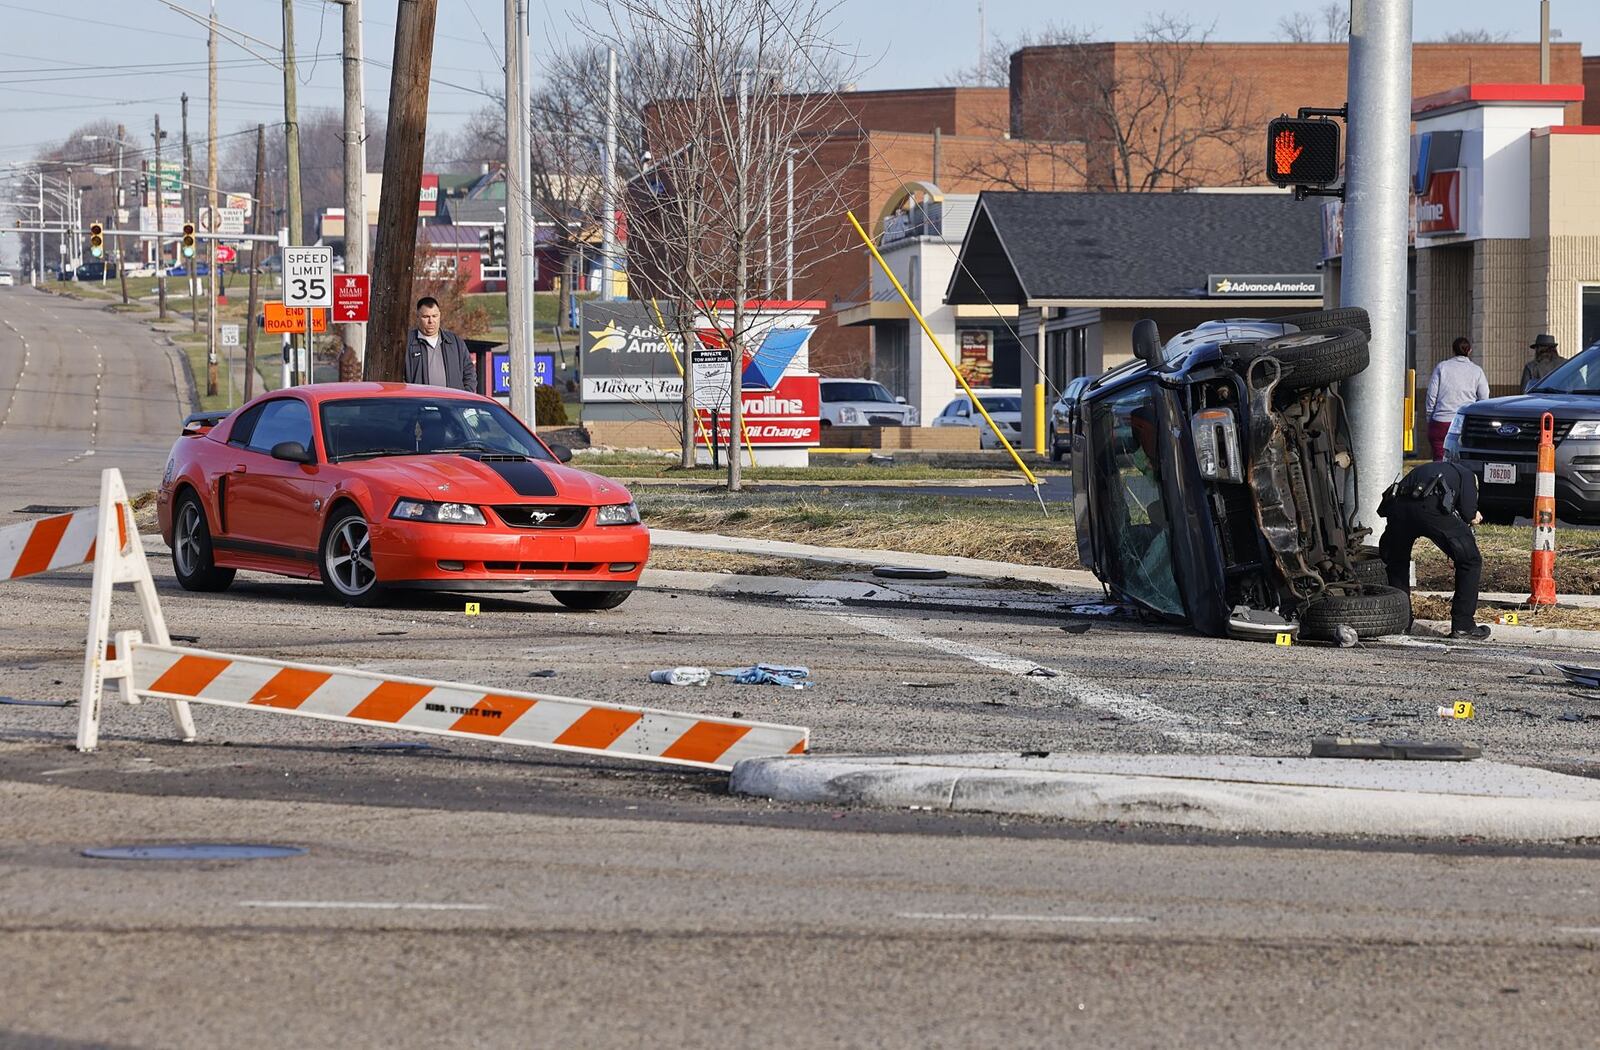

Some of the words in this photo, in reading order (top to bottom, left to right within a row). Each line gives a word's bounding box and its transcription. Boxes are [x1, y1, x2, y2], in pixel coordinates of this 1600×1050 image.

[288, 254, 328, 263] SPEED
[292, 266, 323, 275] LIMIT
[291, 279, 326, 299] 35
[285, 307, 304, 316] END
[267, 320, 293, 329] ROAD
[297, 319, 322, 328] WRK
[224, 335, 237, 343] 35
[626, 339, 684, 353] Americ
[593, 381, 653, 393] Master's
[659, 380, 683, 393] Tou
[744, 426, 761, 437] Oil
[763, 426, 811, 439] Change
[469, 604, 475, 612] 4
[450, 706, 479, 716] STREET
[1458, 704, 1465, 714] 3
